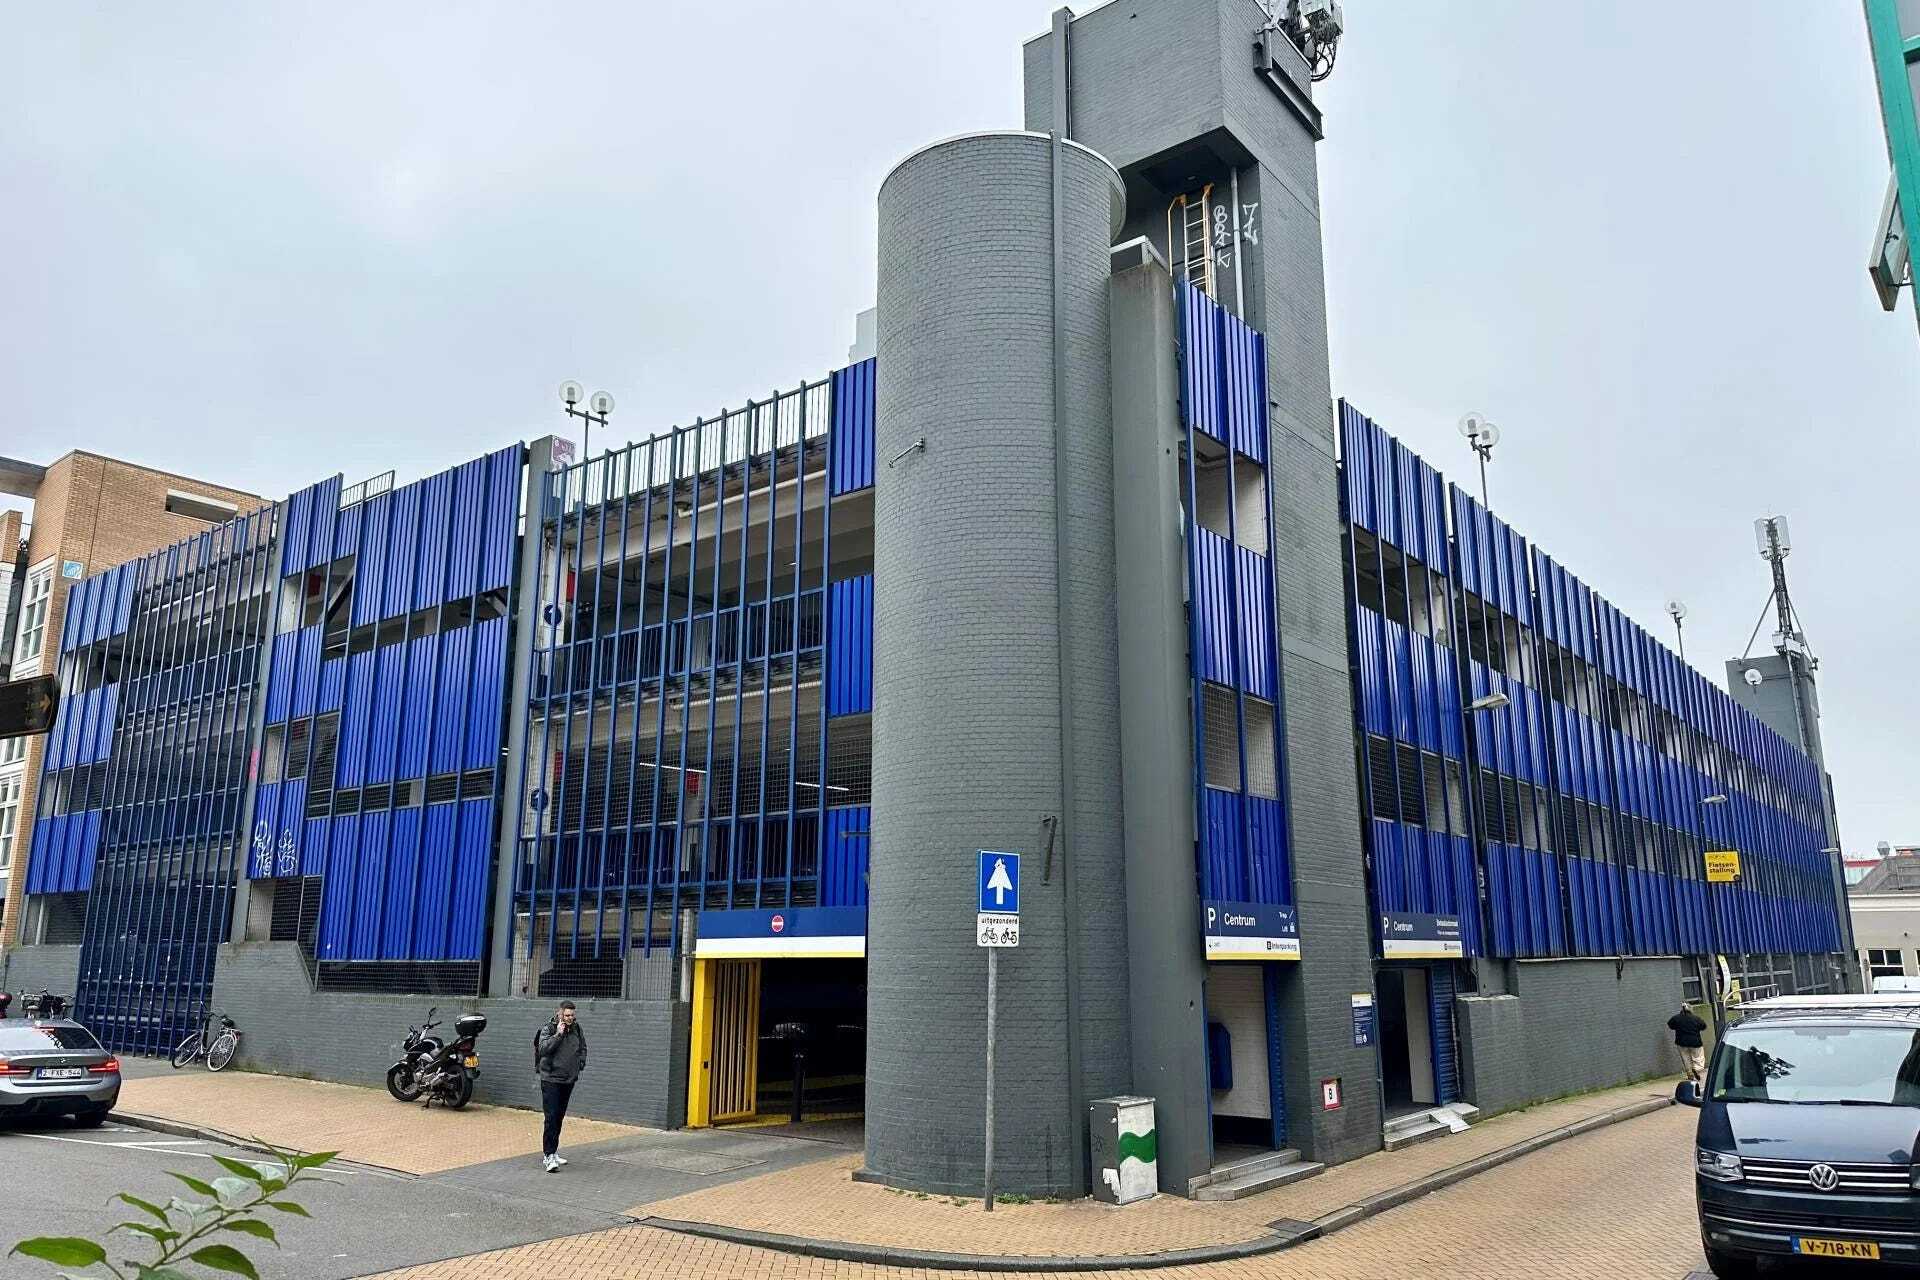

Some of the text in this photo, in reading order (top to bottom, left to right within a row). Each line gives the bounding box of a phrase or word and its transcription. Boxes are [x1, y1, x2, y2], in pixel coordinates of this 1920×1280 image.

[981, 917, 1018, 925] uitgezonderd
[1207, 906, 1256, 929] P Centrum
[1383, 916, 1414, 935] P Centrum
[1806, 1241, 1872, 1256] V-718-KN
